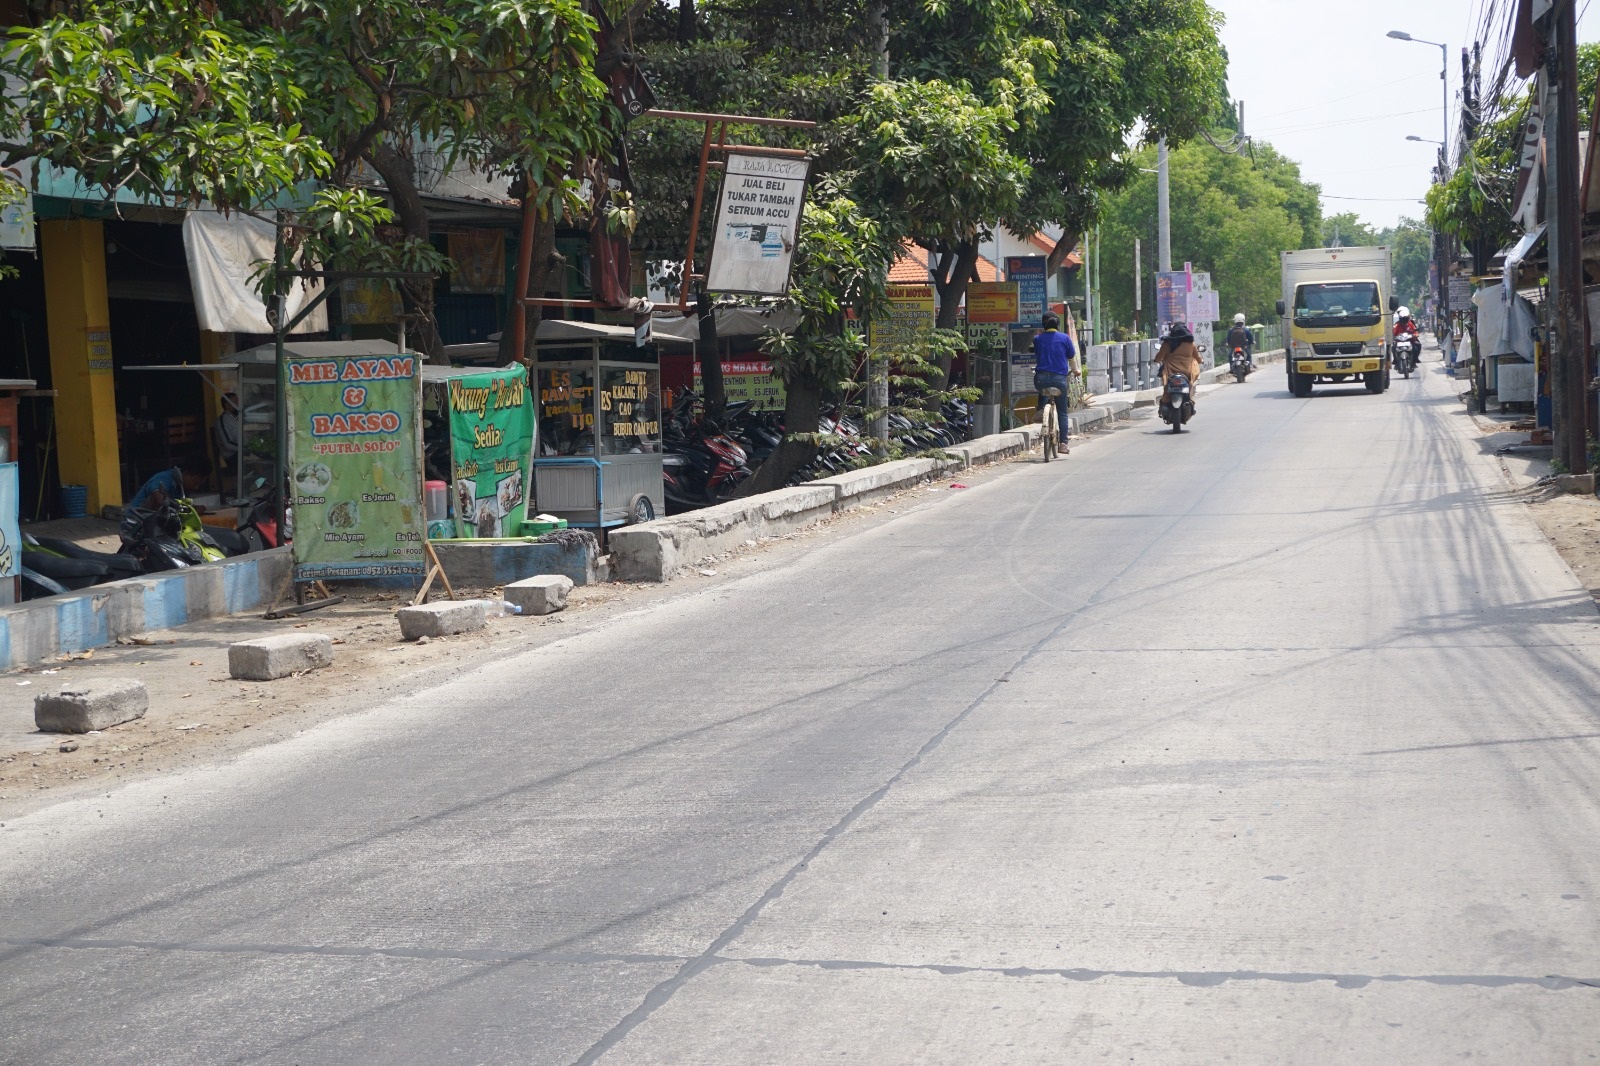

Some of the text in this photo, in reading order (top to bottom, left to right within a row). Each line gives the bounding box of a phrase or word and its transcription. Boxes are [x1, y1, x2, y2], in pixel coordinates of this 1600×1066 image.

[741, 178, 786, 191] JUAL BELI
[727, 191, 795, 205] TUKAR TAMBAH
[727, 205, 790, 219] SETRUM ACCU
[290, 358, 414, 383] MIE AYAM
[732, 362, 759, 372] MBAK
[551, 370, 570, 386] ES
[625, 370, 646, 384] DAWET
[344, 387, 366, 407] &
[451, 379, 489, 419] Warung
[542, 386, 594, 401] DAWET
[612, 385, 648, 402] KACANG IJO
[754, 388, 761, 397] ES
[762, 387, 780, 396] JERUK
[601, 390, 611, 411] ES
[619, 402, 631, 415] CAO
[312, 412, 400, 435] BAKSO
[572, 413, 594, 430] IJO
[613, 421, 658, 436] BUBUR CAMPUR
[298, 496, 325, 504] Bakso
[362, 493, 396, 503] Es Jeruk
[325, 533, 364, 542] Mie Ayam
[298, 569, 326, 578] Terima
[327, 566, 361, 576] Pesanan:
